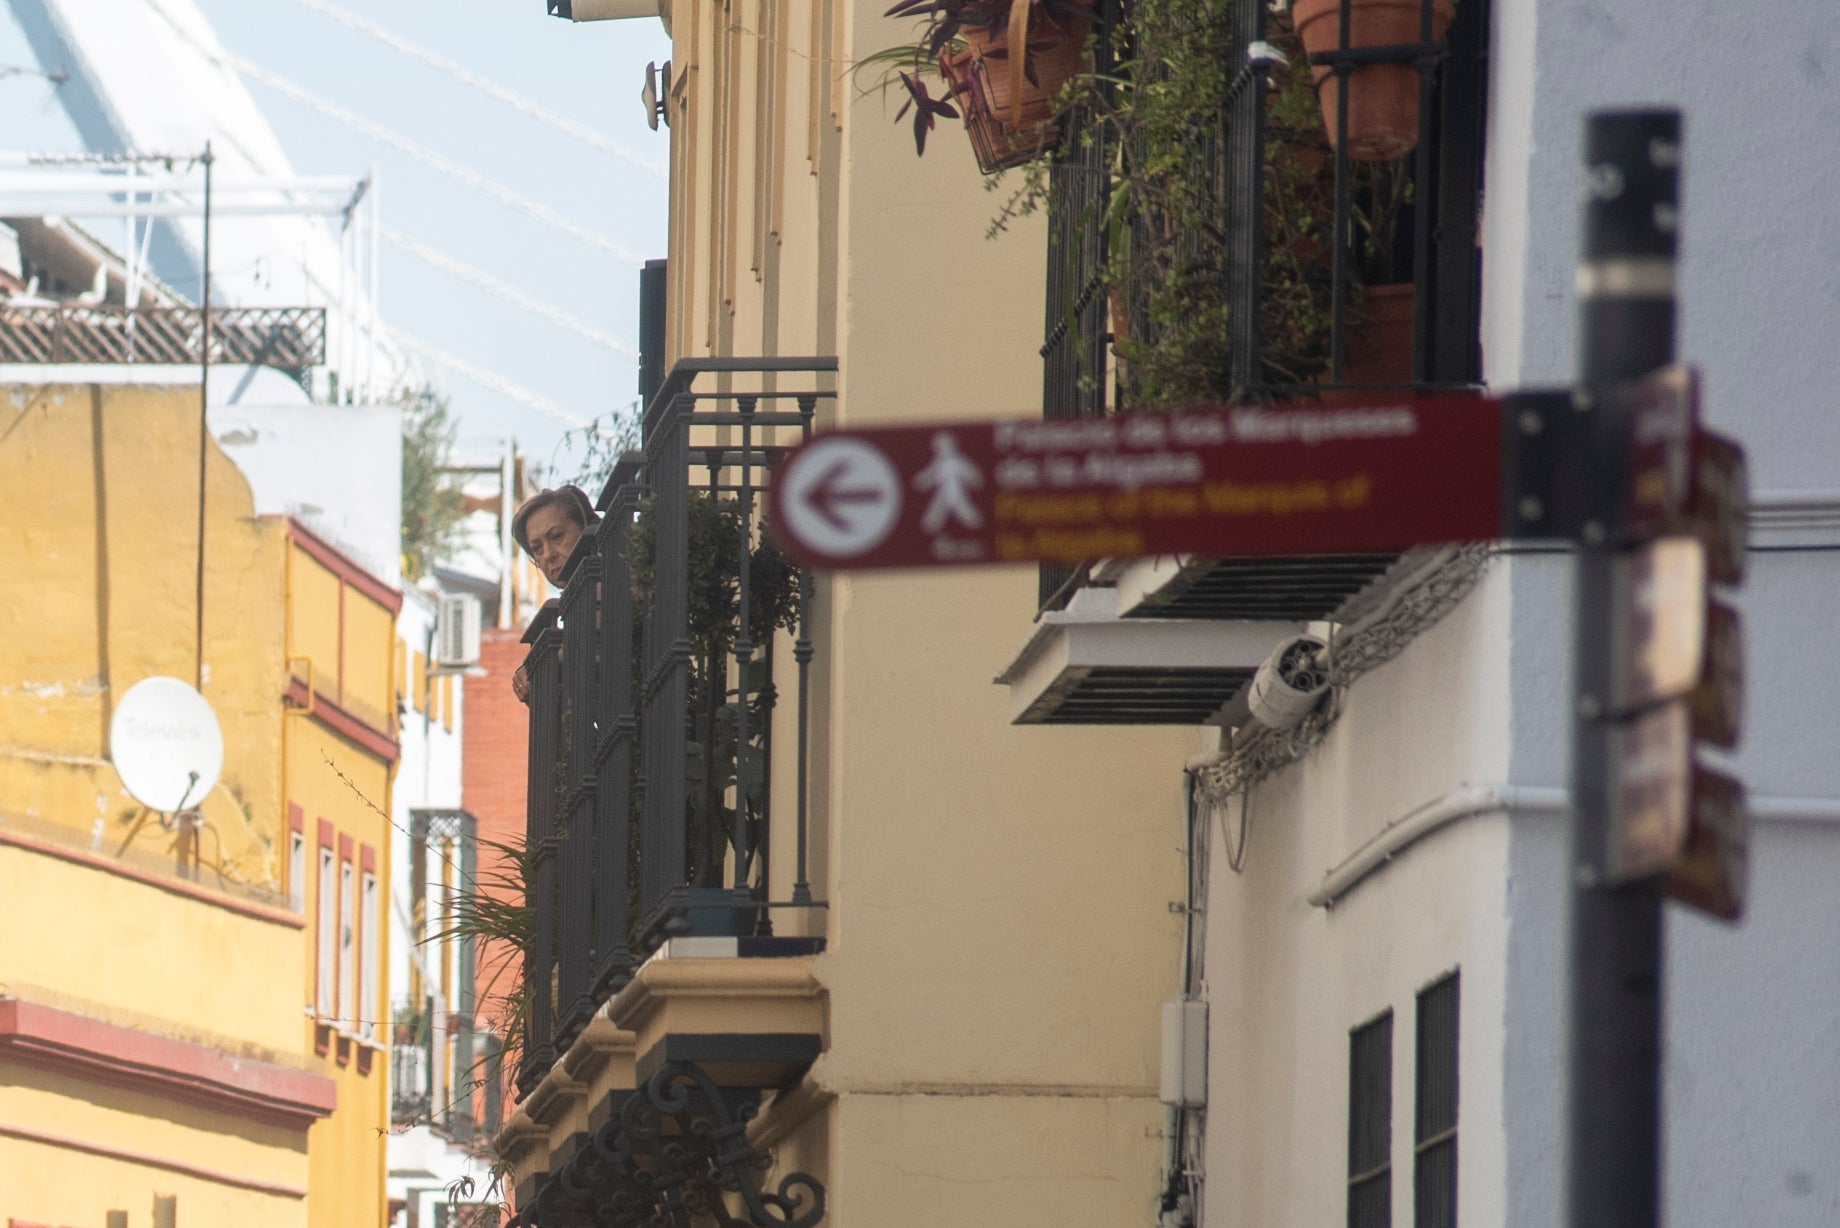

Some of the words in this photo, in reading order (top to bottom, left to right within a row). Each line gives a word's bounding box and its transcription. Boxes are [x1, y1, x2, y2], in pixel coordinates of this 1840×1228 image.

[1123, 416, 1166, 446] de
[1171, 414, 1225, 444] los
[994, 458, 1040, 488] de
